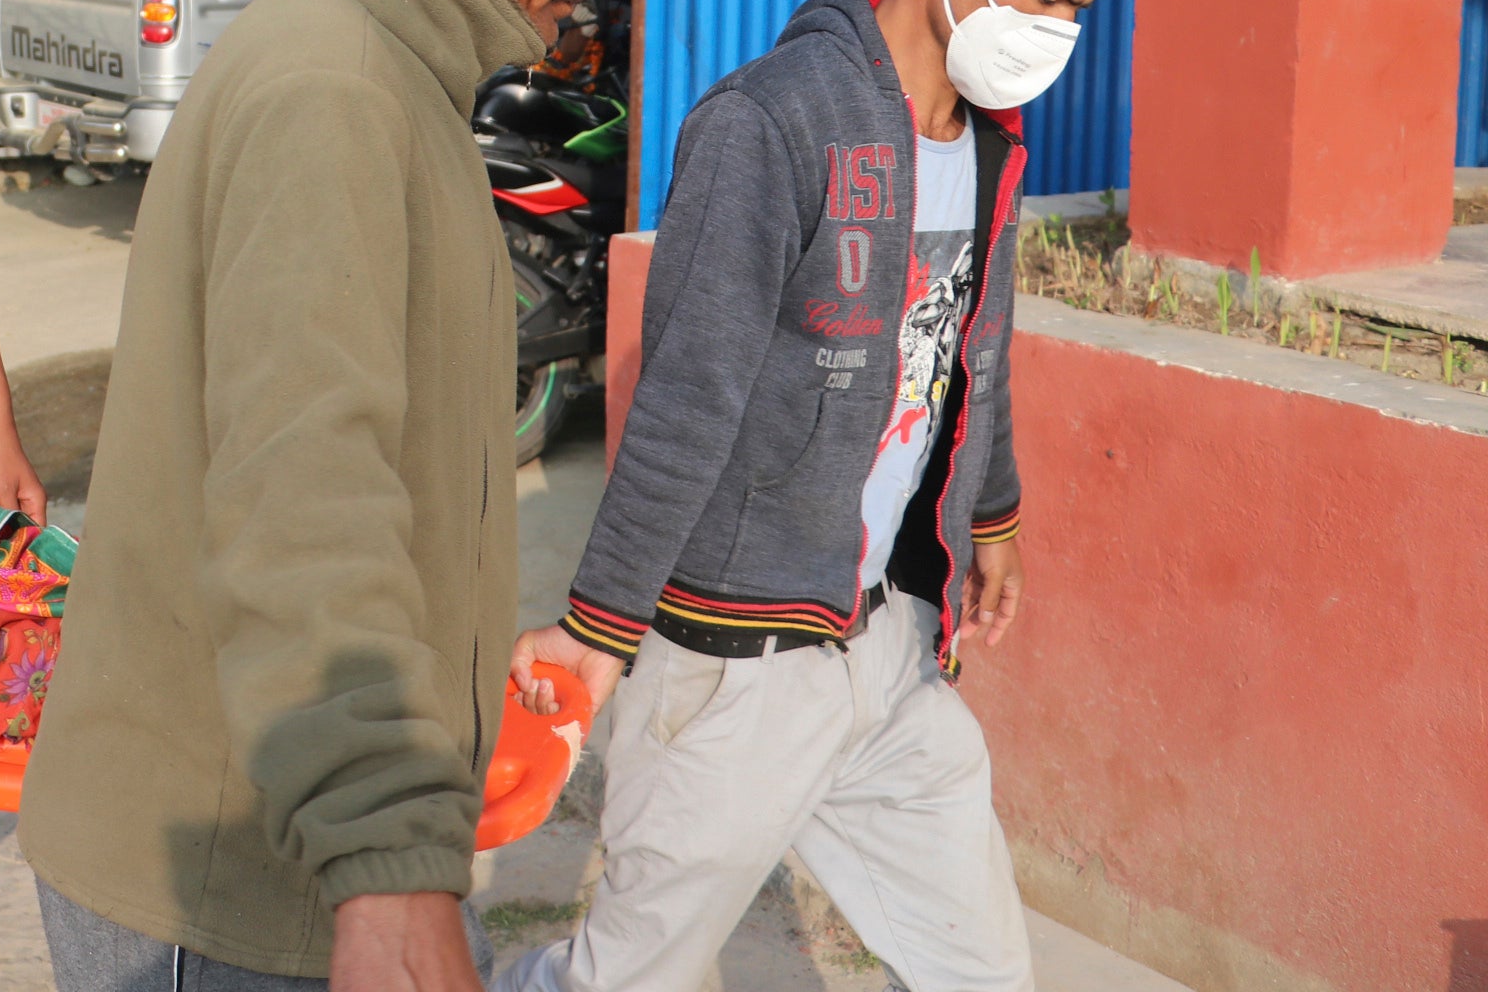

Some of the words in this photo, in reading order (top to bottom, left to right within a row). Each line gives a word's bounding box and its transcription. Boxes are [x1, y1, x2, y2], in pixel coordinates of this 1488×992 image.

[11, 25, 124, 78] Mahindra
[802, 299, 884, 338] Golden
[815, 347, 868, 369] CLOTHING
[824, 372, 853, 390] CLUB
